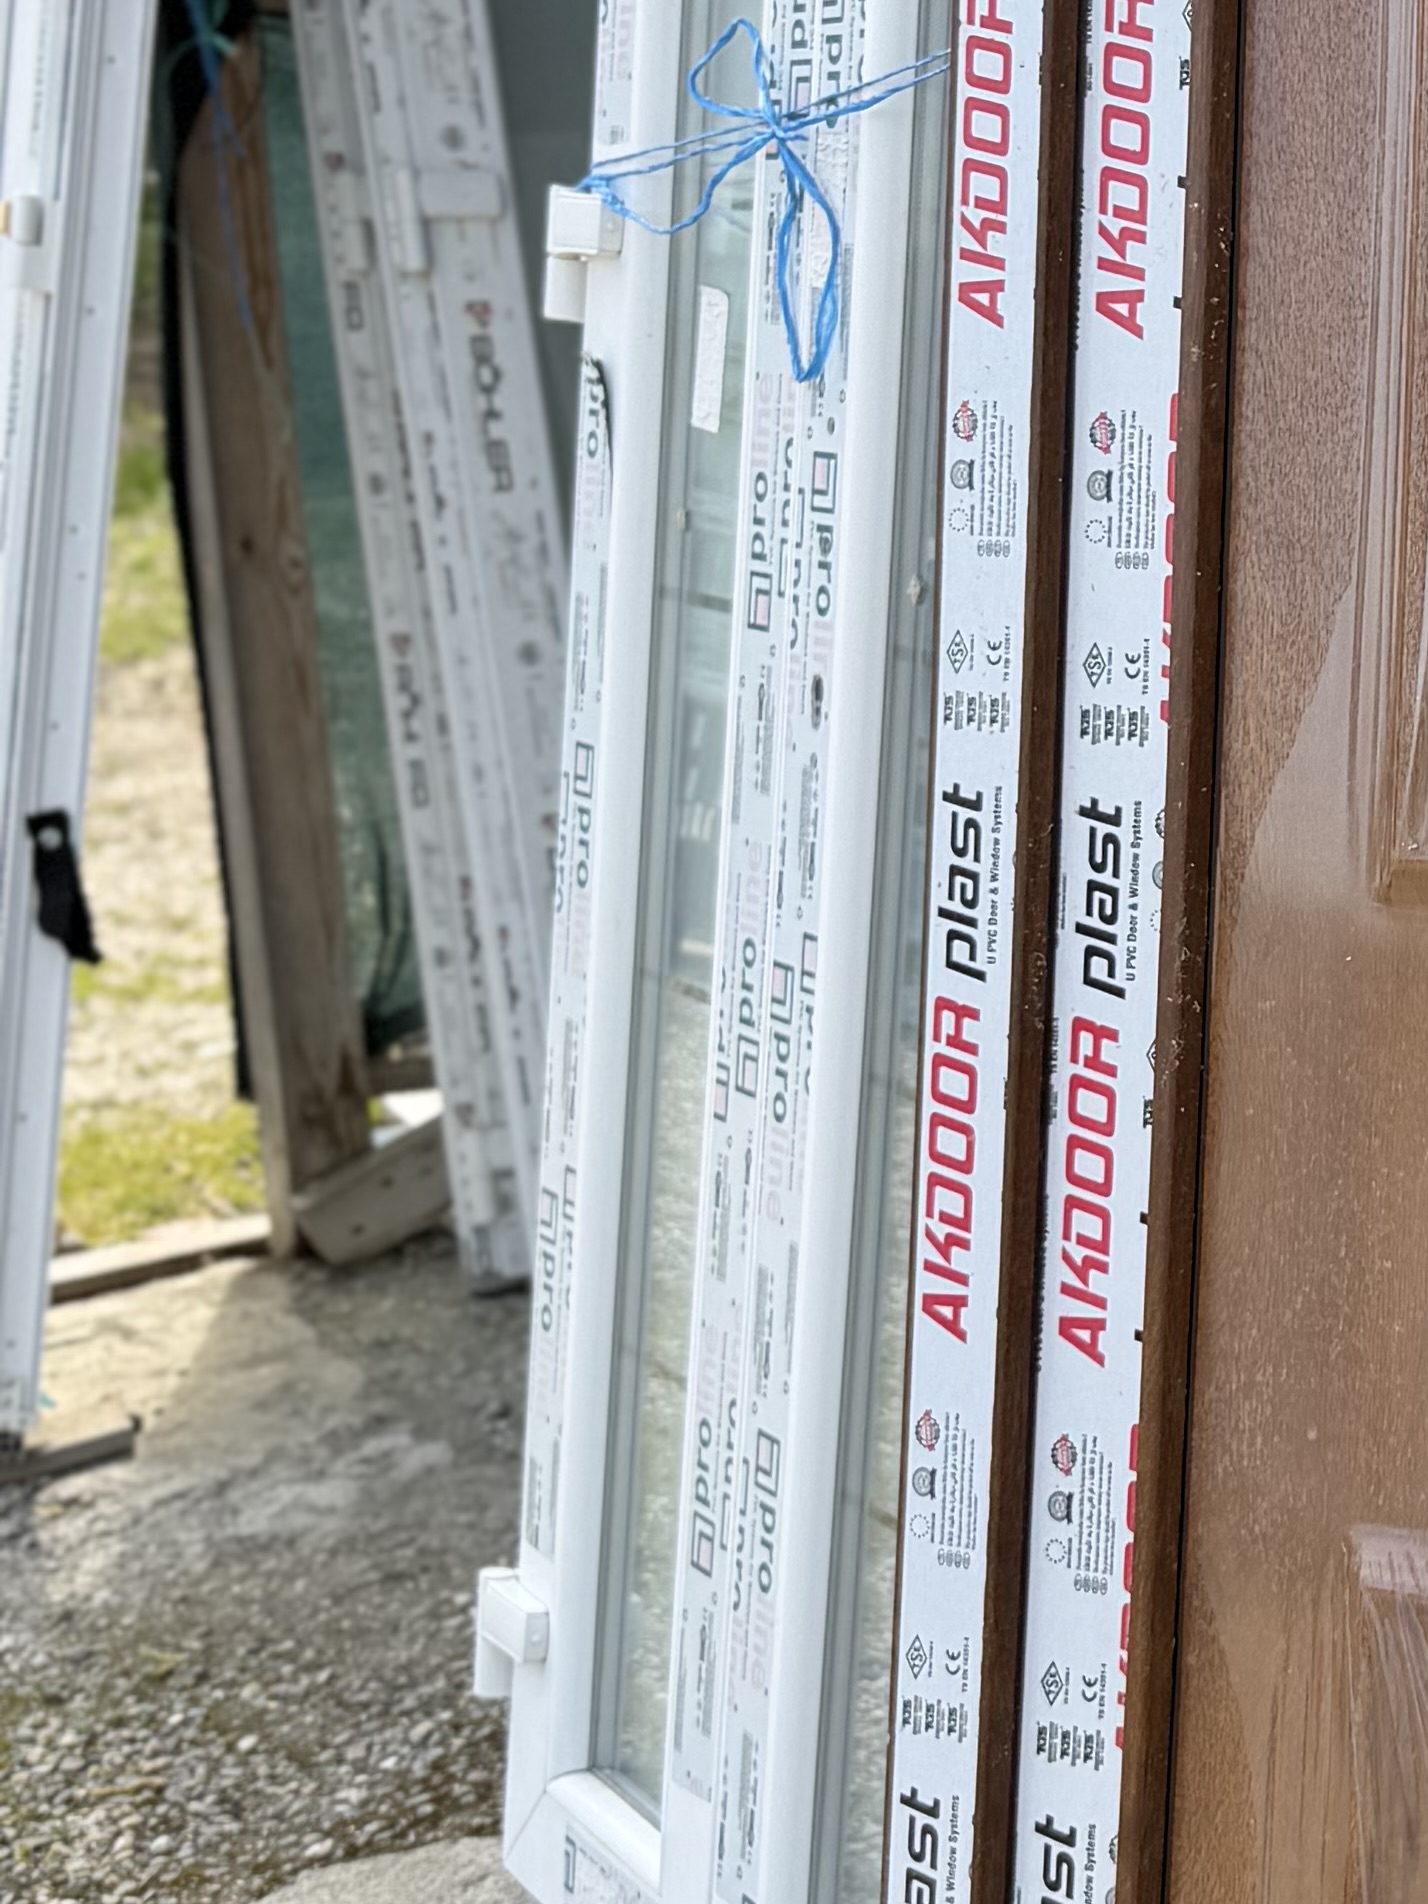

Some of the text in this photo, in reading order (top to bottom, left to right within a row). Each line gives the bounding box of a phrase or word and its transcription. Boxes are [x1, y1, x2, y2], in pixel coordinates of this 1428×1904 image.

[921, 782, 986, 1344] AKDOOR plast
[1074, 796, 1125, 1000] plast
[1058, 1016, 1119, 1367] AKDOOR
